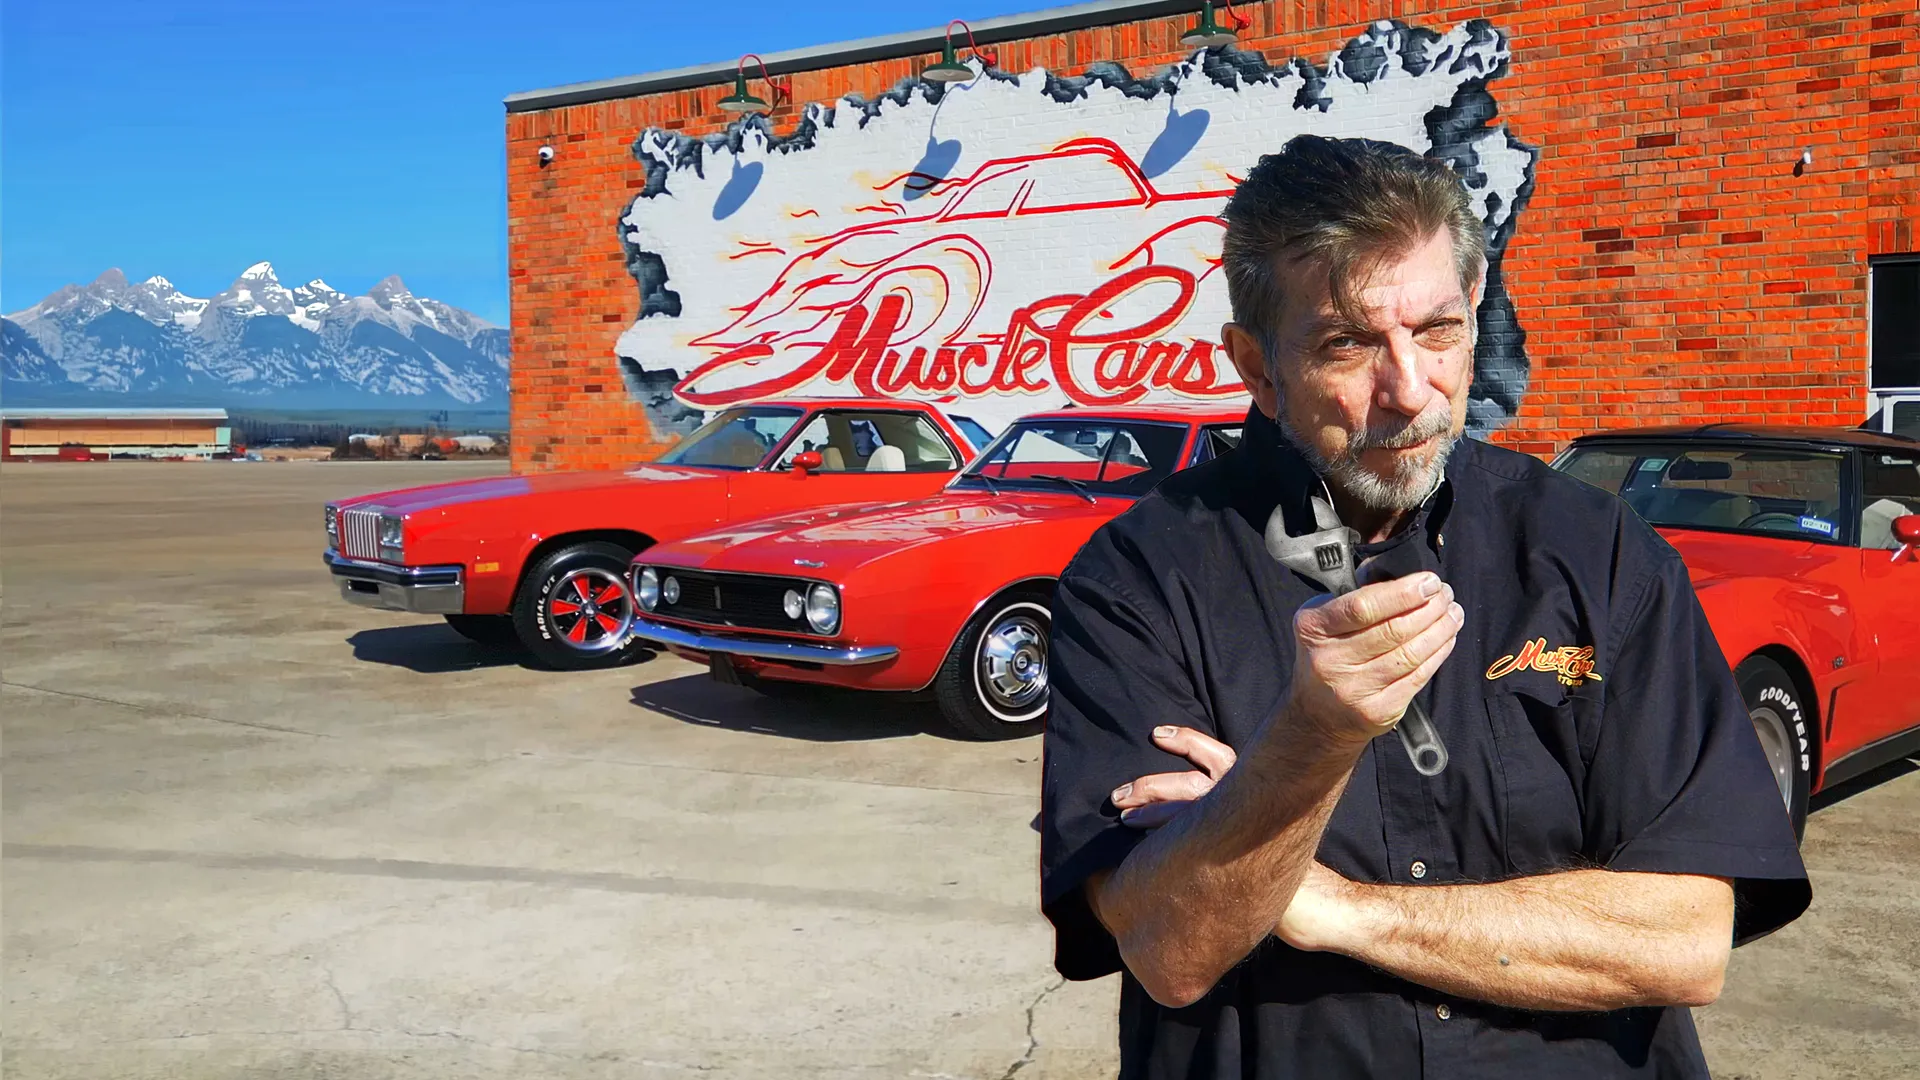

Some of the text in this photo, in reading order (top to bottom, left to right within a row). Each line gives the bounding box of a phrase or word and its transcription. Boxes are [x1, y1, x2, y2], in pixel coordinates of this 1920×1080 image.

[673, 265, 1251, 410] Muscle Cars
[537, 598, 552, 640] RADIAL
[1486, 637, 1566, 680] Musle
[1760, 687, 1810, 771] GOODYEAR
